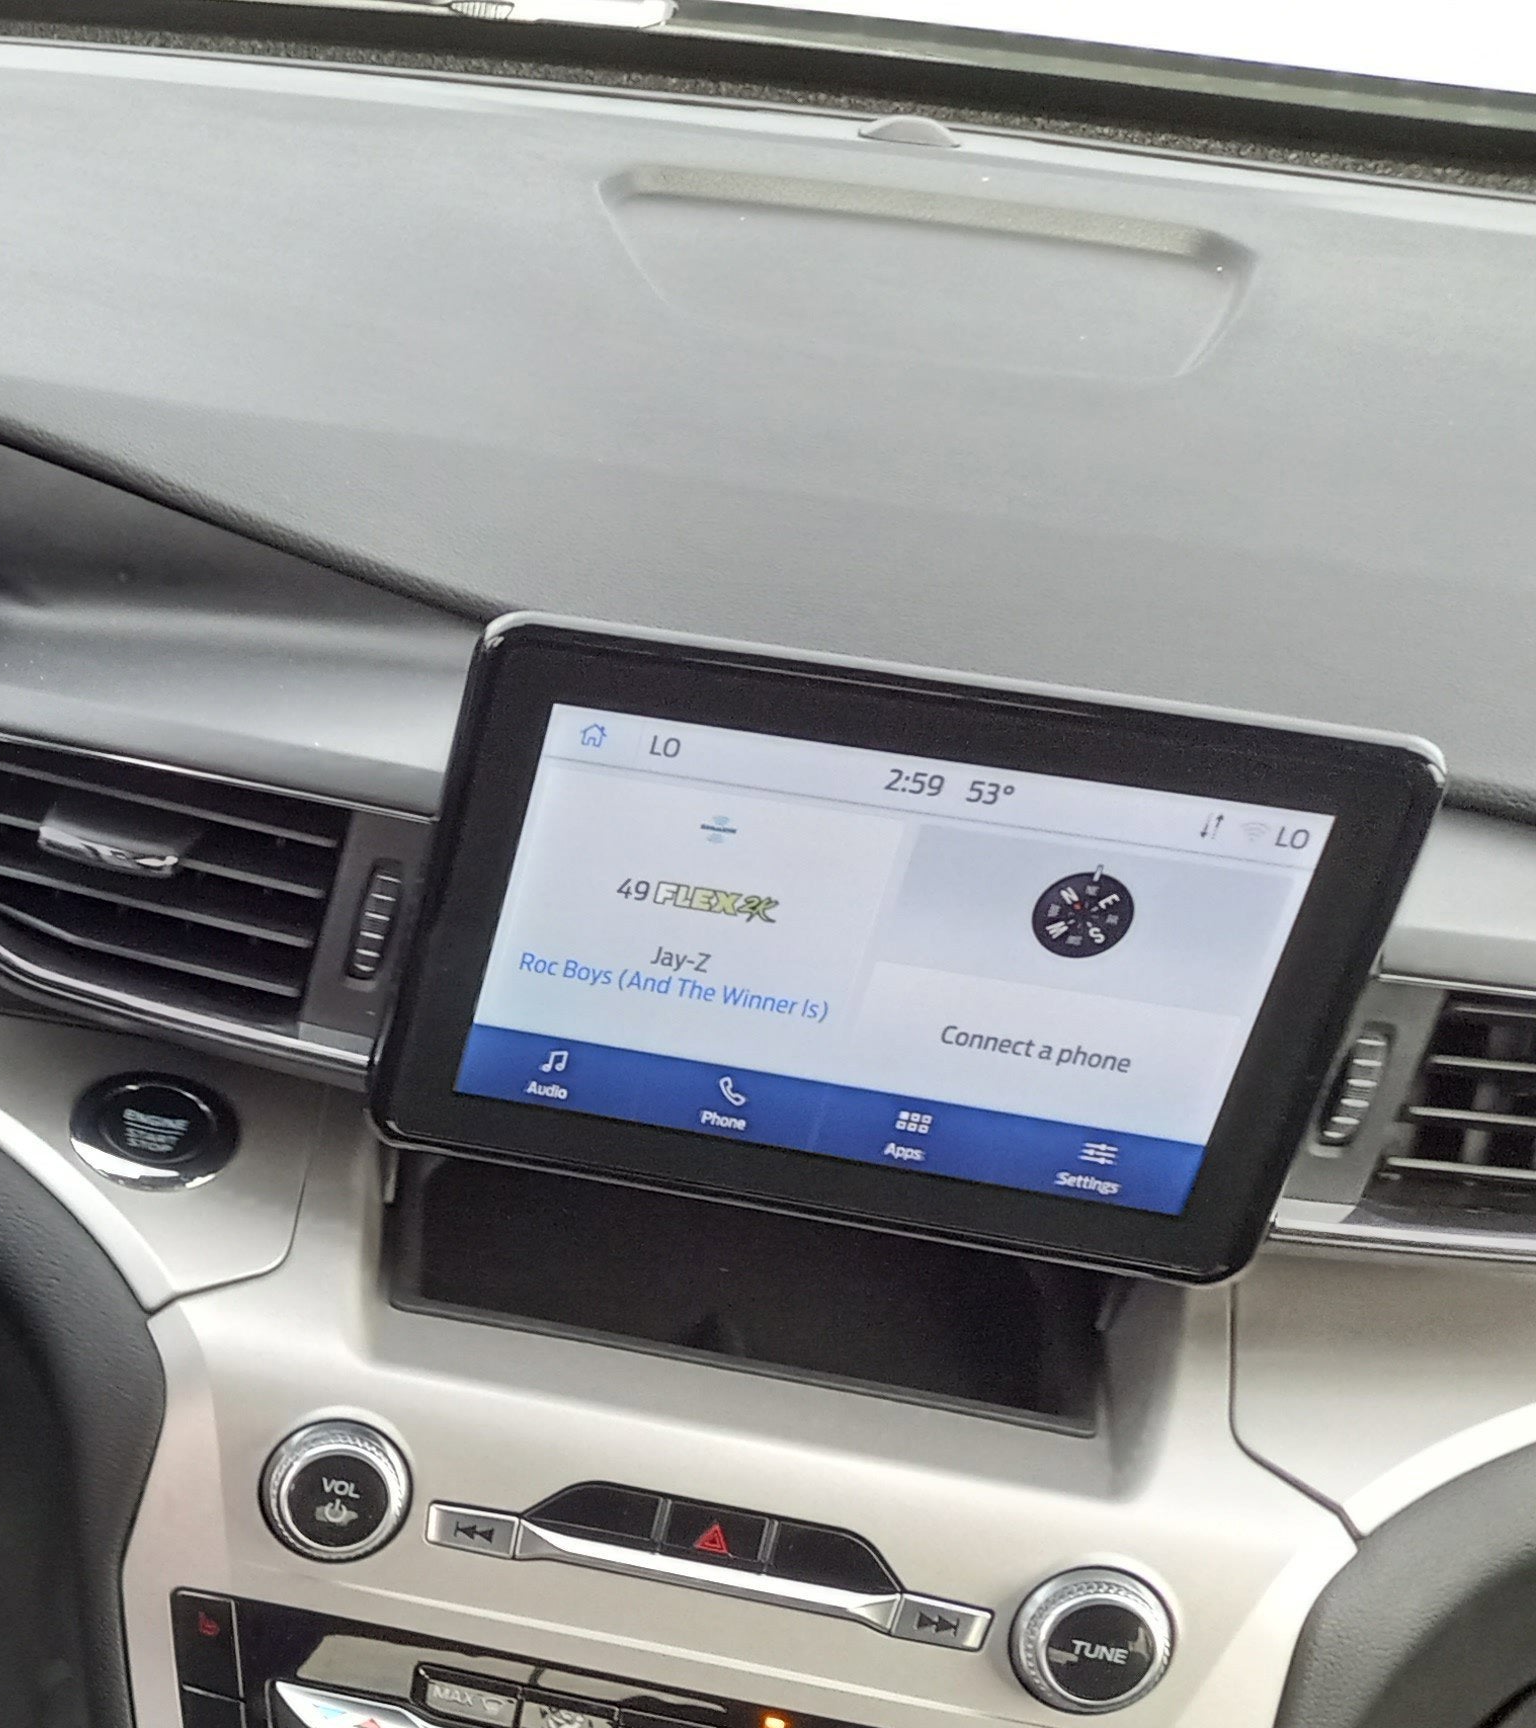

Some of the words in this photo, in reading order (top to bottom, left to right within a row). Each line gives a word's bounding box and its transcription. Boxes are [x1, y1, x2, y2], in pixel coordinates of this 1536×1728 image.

[649, 734, 681, 759] LO
[884, 769, 945, 797] 2:59
[966, 781, 1016, 805] 53°
[1274, 827, 1311, 850] LO
[617, 878, 650, 901] 49
[1060, 886, 1079, 905] N
[1098, 894, 1120, 909] E
[1089, 927, 1105, 944] S
[650, 945, 712, 974] Jay-Z
[519, 952, 558, 977] Roc
[562, 959, 612, 987] Boys
[618, 968, 672, 996] (And
[677, 978, 716, 1003] The
[722, 985, 797, 1015] Winner
[801, 1000, 830, 1023] Is)
[940, 1024, 1033, 1058] Connect
[1037, 1042, 1053, 1061] a
[1056, 1043, 1132, 1074] phone
[527, 1080, 568, 1100] Audio
[700, 1110, 746, 1132] Phone
[884, 1142, 924, 1163] Apps
[1054, 1171, 1121, 1196] Settings
[322, 1477, 360, 1499] VOL
[1071, 1639, 1128, 1665] TUNE
[432, 1684, 473, 1706] MAX
